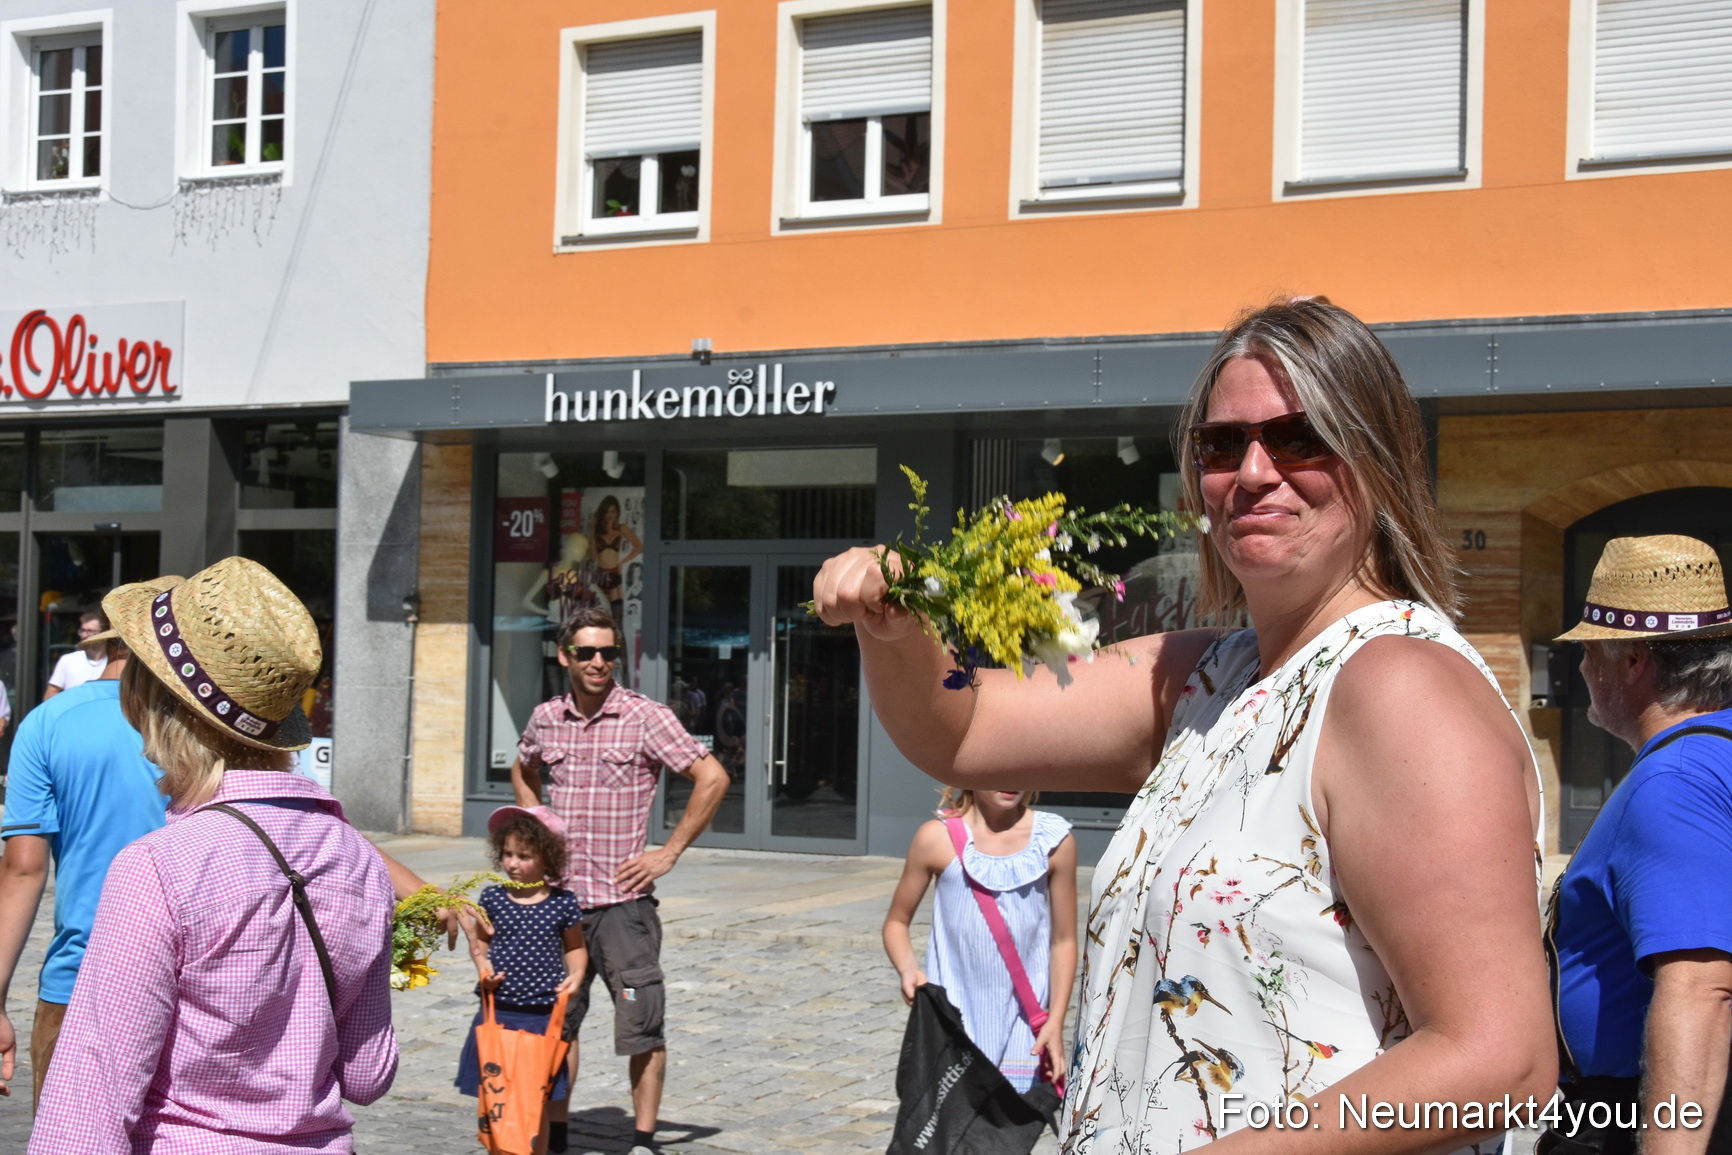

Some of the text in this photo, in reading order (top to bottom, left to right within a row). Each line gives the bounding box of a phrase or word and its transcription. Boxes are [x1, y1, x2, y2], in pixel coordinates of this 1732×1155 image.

[545, 363, 836, 423] hunkemöller
[502, 508, 544, 538] -20%
[1462, 530, 1486, 551] 30
